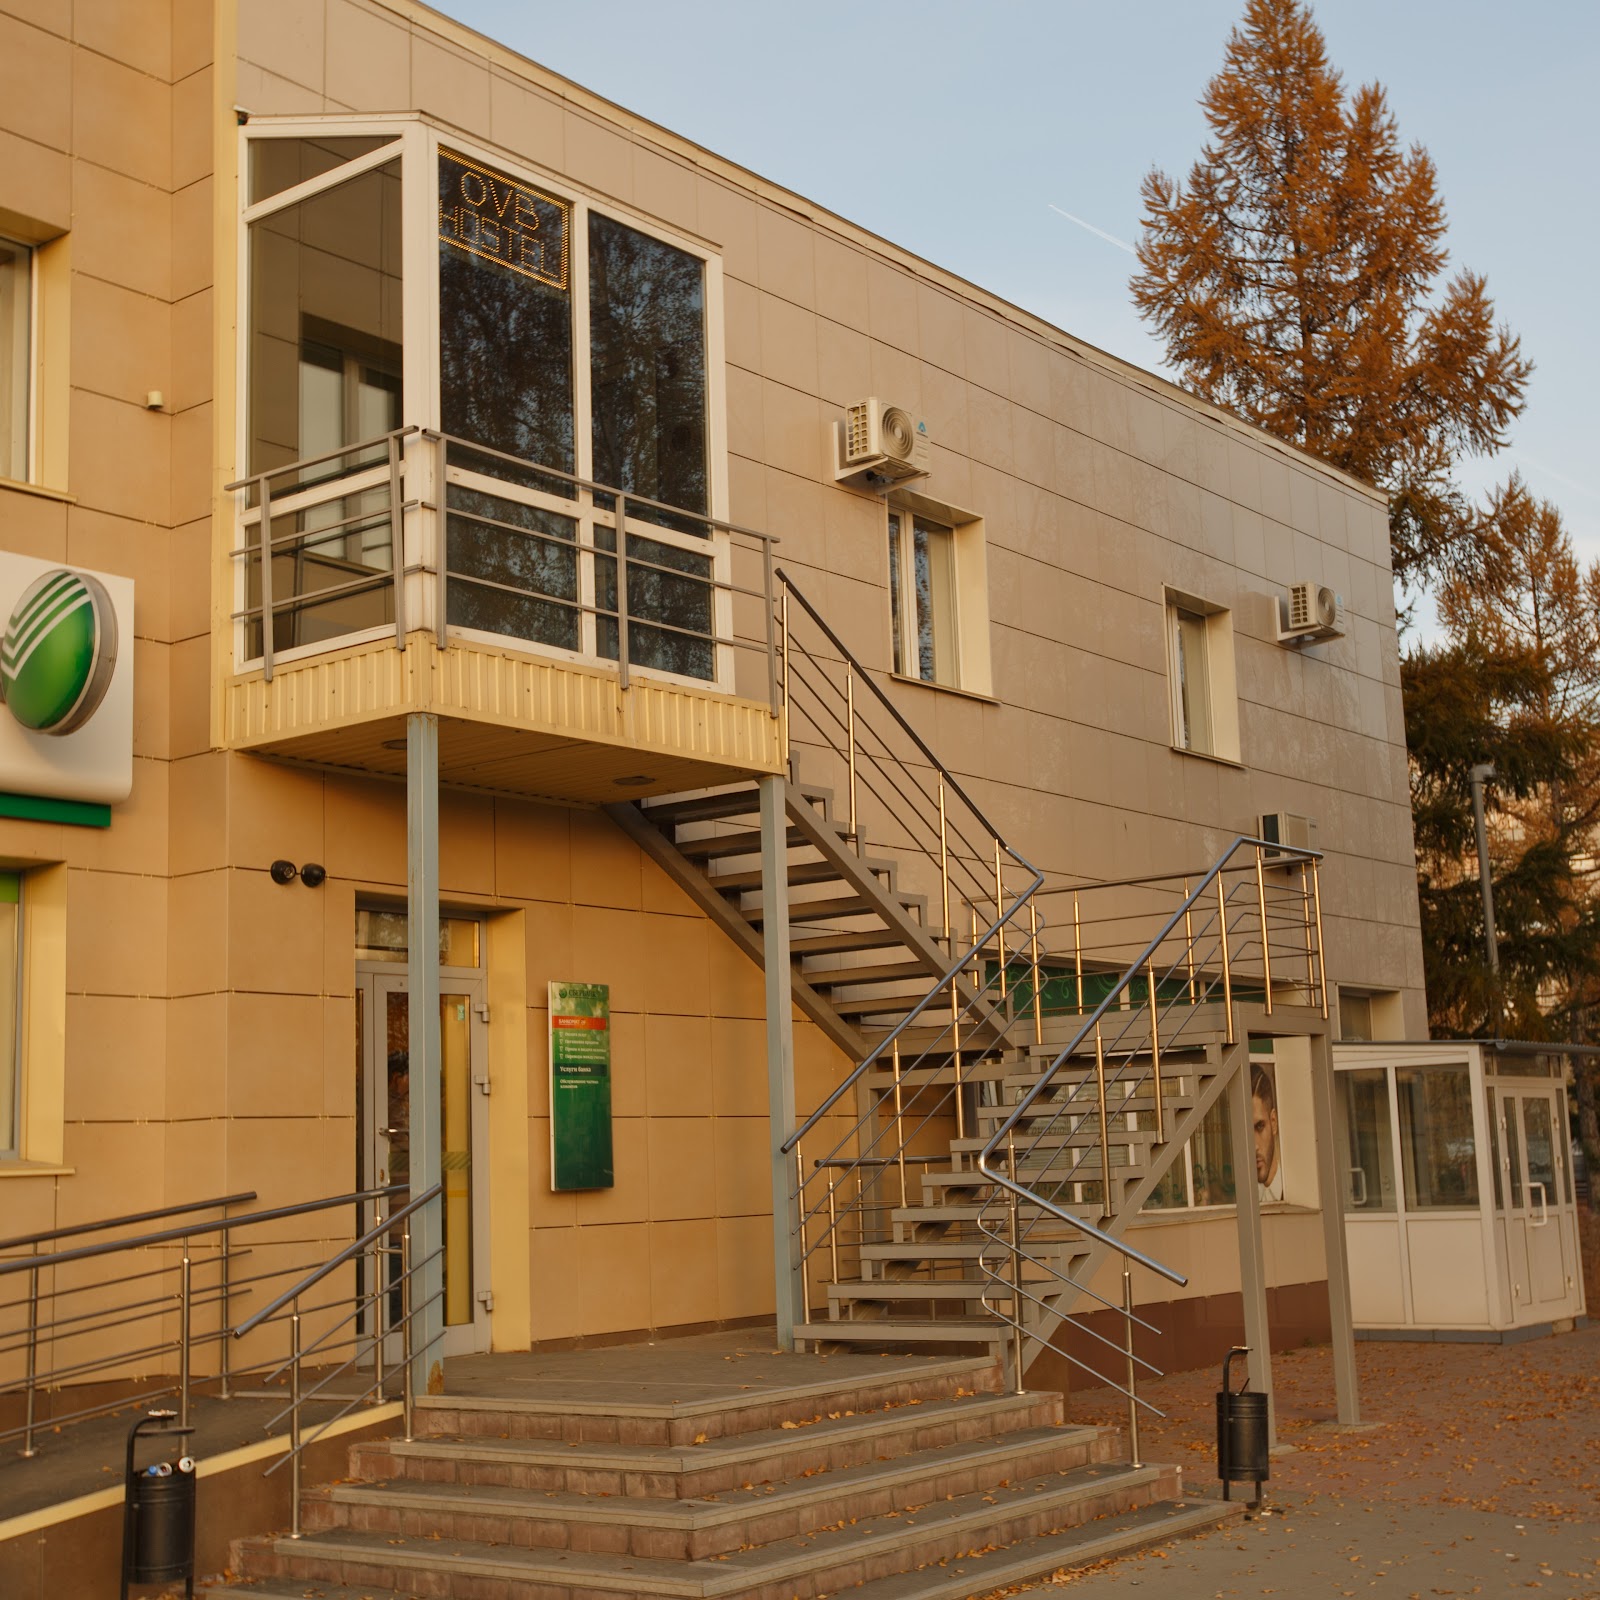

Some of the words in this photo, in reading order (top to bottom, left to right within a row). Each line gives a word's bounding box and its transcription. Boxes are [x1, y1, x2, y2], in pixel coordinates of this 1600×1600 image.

[460, 171, 540, 231] OVB
[439, 199, 559, 279] HOSTEL
[559, 1066, 578, 1074] Услуги
